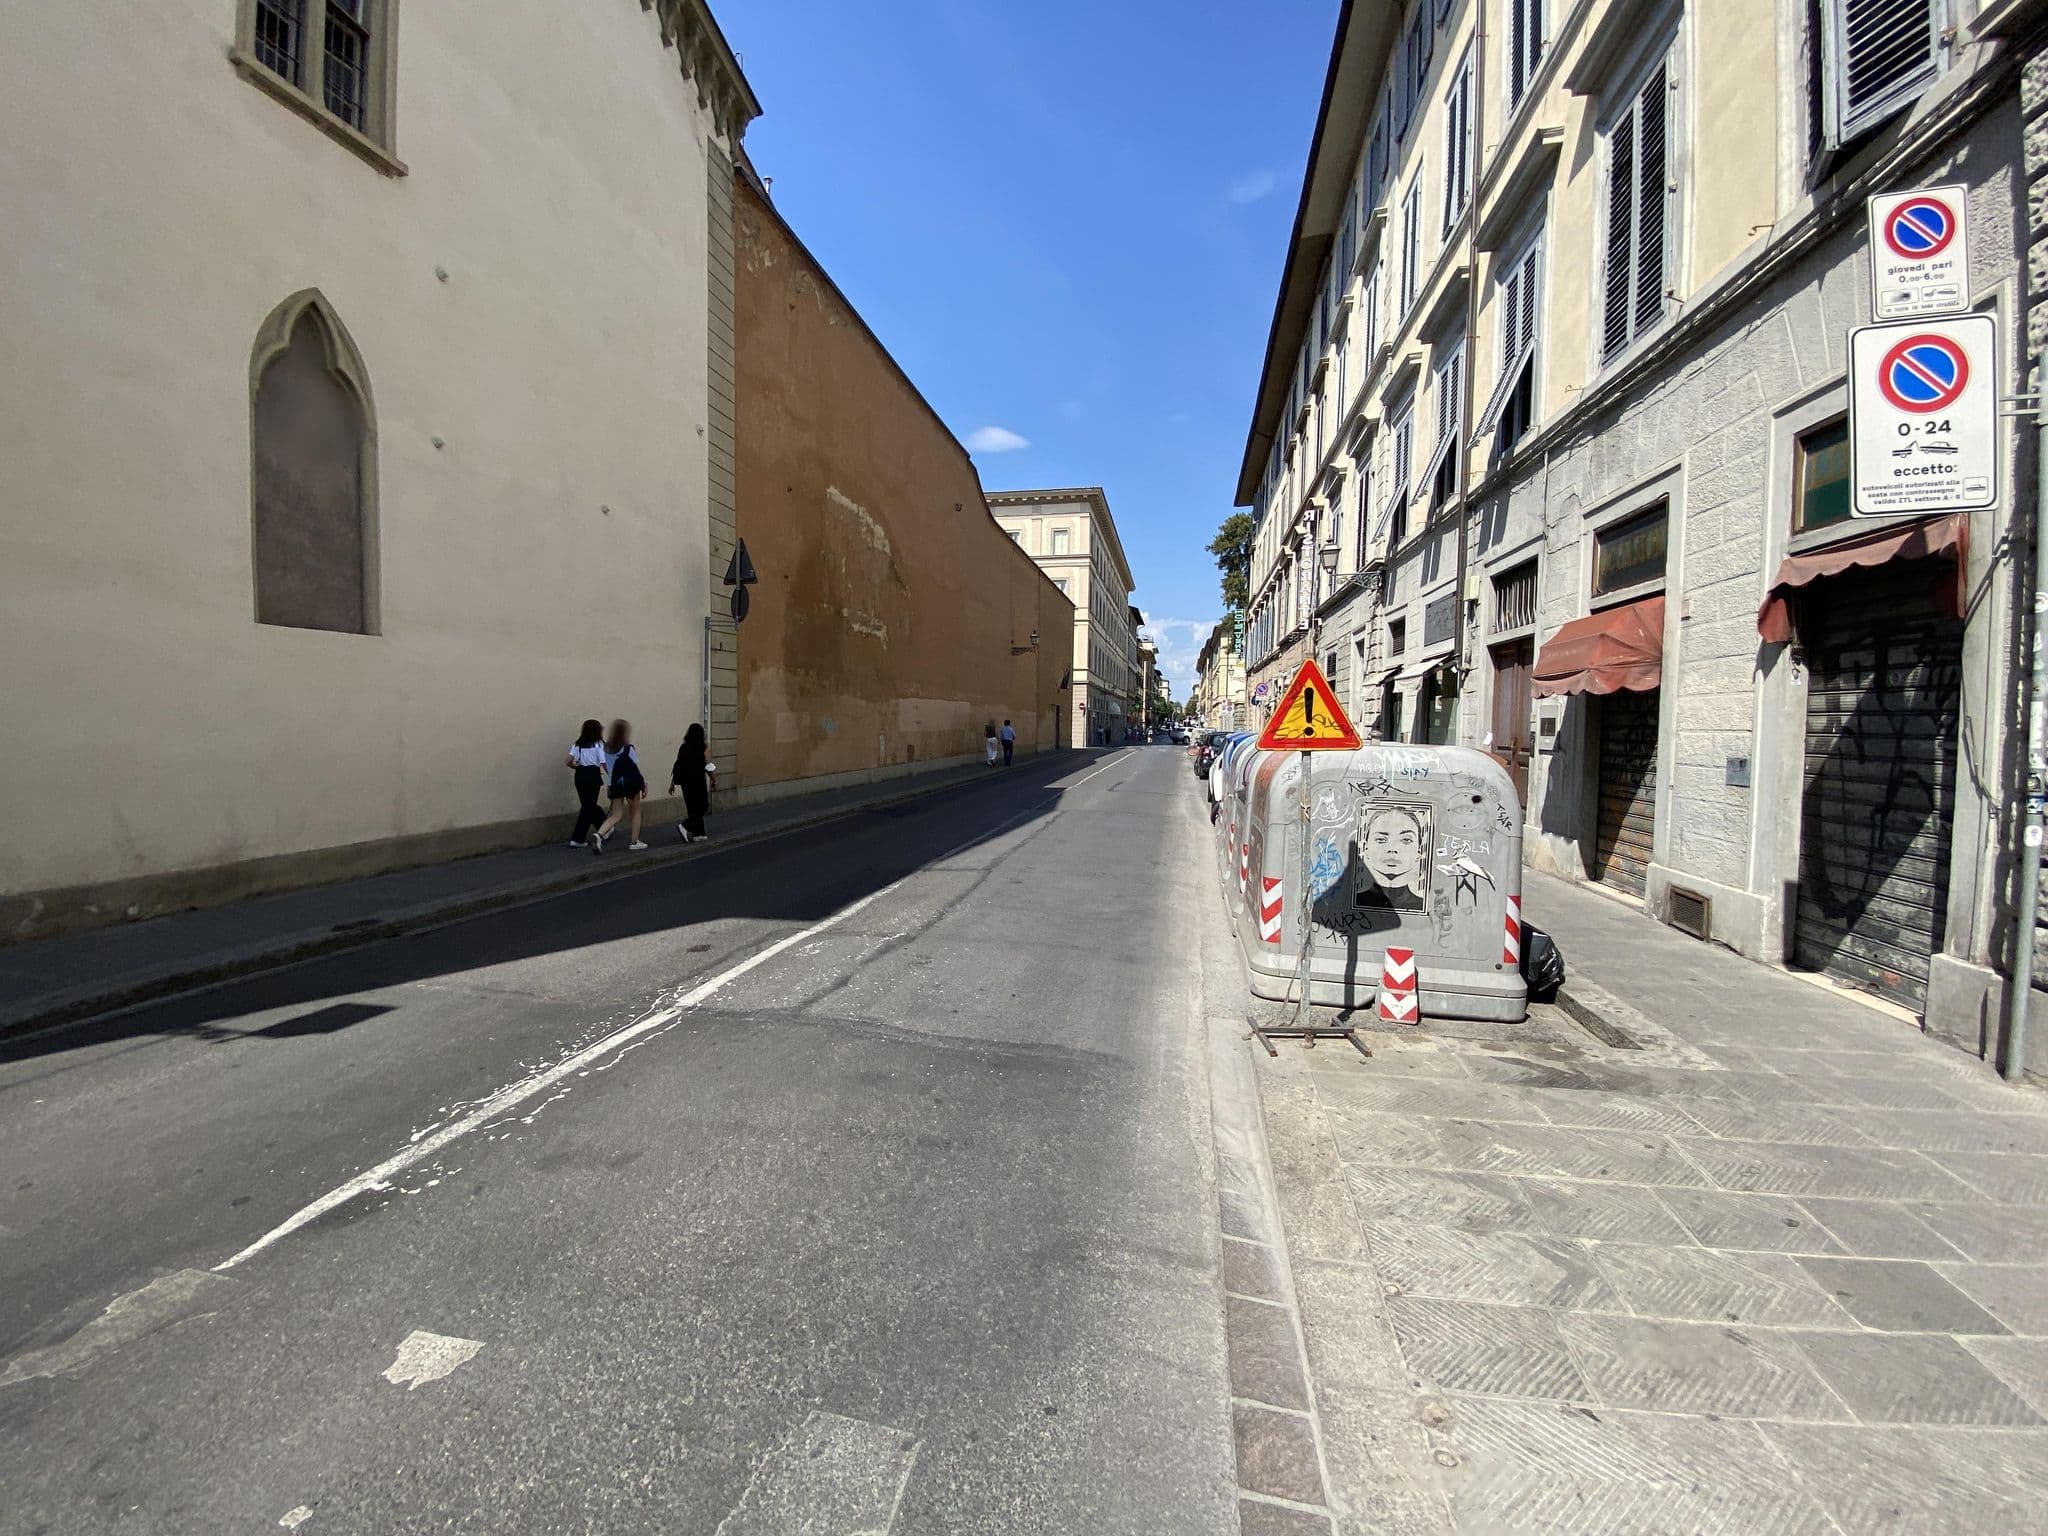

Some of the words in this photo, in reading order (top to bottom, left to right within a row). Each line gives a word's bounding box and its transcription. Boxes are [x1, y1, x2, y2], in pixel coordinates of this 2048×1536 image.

[1931, 260, 1952, 271] pari
[1924, 420, 1951, 435] 24
[1894, 464, 1957, 476] eccetto:
[1440, 832, 1491, 855] TESLA
